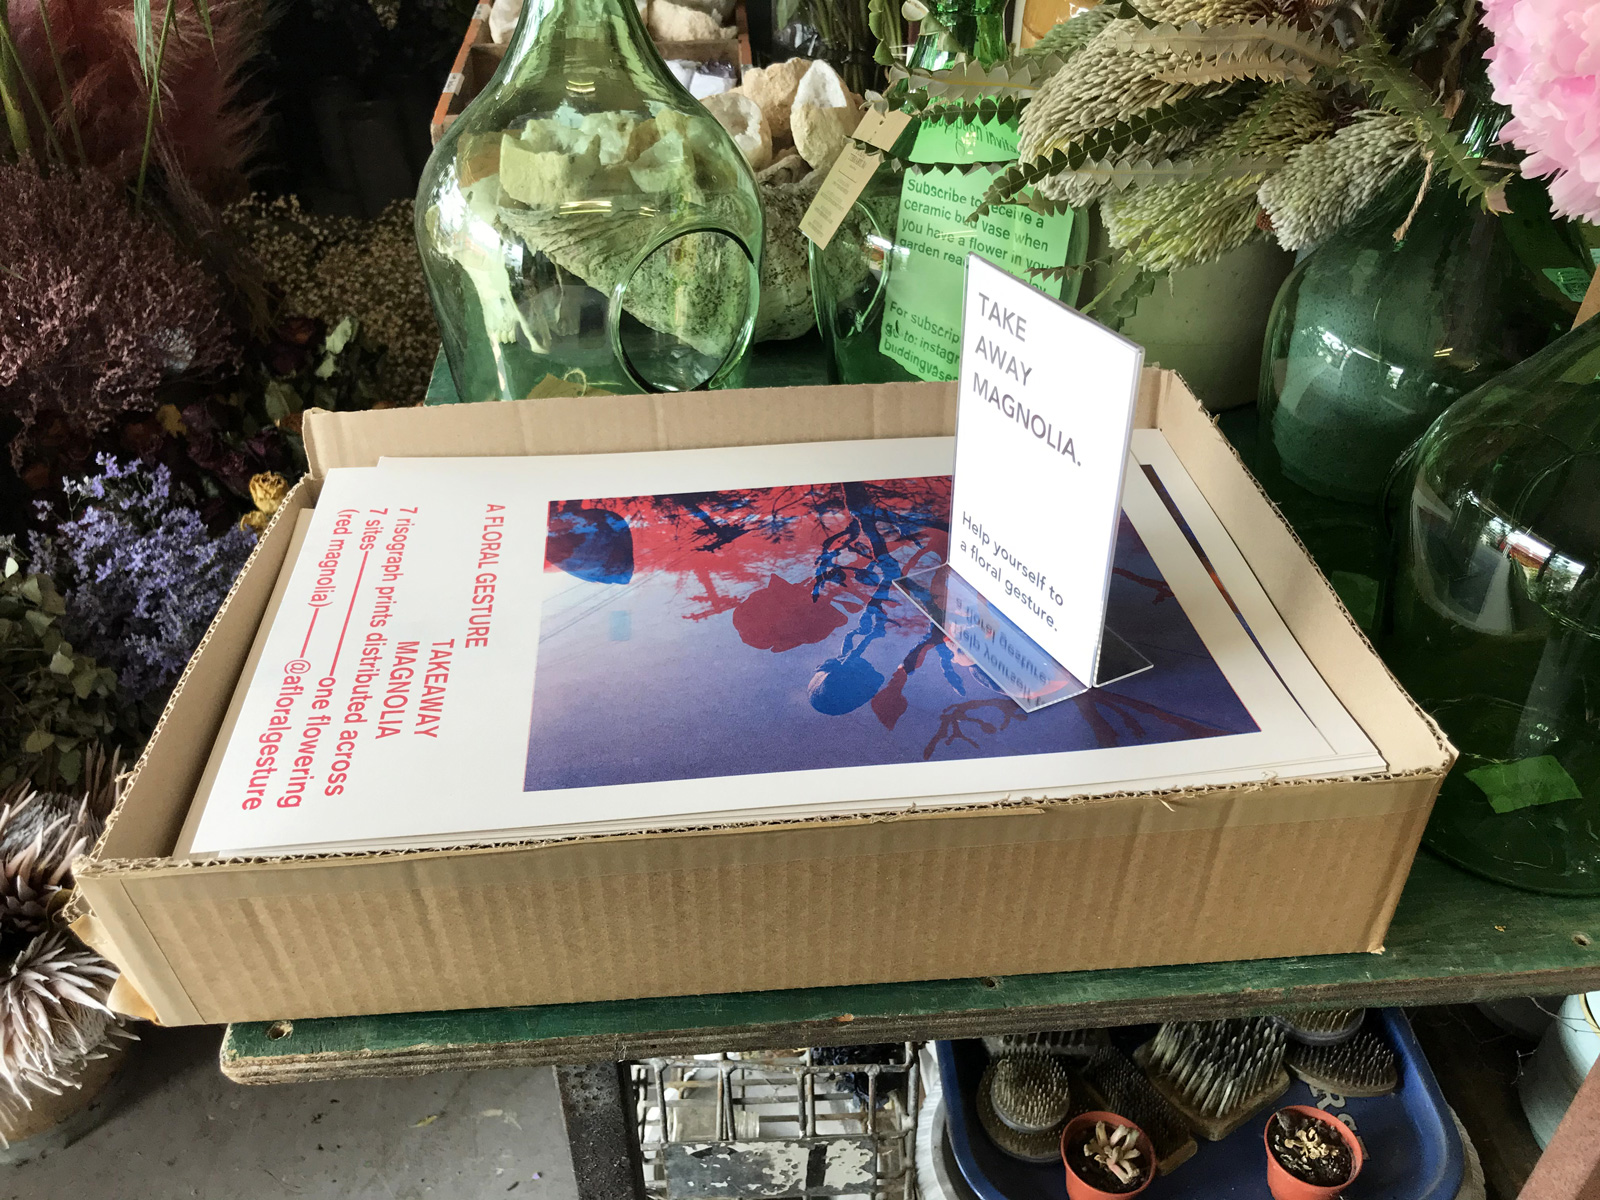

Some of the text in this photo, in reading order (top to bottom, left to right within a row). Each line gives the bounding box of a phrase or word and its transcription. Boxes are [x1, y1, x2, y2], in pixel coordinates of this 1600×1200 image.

[904, 199, 951, 220] ceramic
[982, 220, 1010, 240] vase
[1015, 233, 1048, 252] when
[907, 179, 1044, 229] Subscribe to eceive a
[899, 238, 967, 268] garden rea
[901, 218, 1055, 270] you have a flower in you
[890, 301, 960, 344] For subscrip
[978, 292, 1027, 342] TAKE
[904, 331, 918, 345] to:
[920, 337, 960, 365] instagr
[975, 335, 1032, 386] AWAY
[973, 372, 1081, 467] MAGNOLIA.
[359, 519, 384, 551] sites
[381, 518, 415, 581] risograph
[962, 511, 1064, 607] Help yourself to
[465, 503, 506, 648] A FLORAL GESTURE
[960, 540, 1058, 632] a floral gesture.
[370, 586, 397, 628] prints
[242, 509, 360, 810] (red magnolia) @afloralgesture
[343, 632, 388, 724] distributed
[413, 638, 455, 738] TAKEAWAY
[311, 677, 336, 710] one
[375, 640, 420, 739] MAGNOLIA
[276, 714, 331, 808] flowering
[324, 729, 358, 796] across
